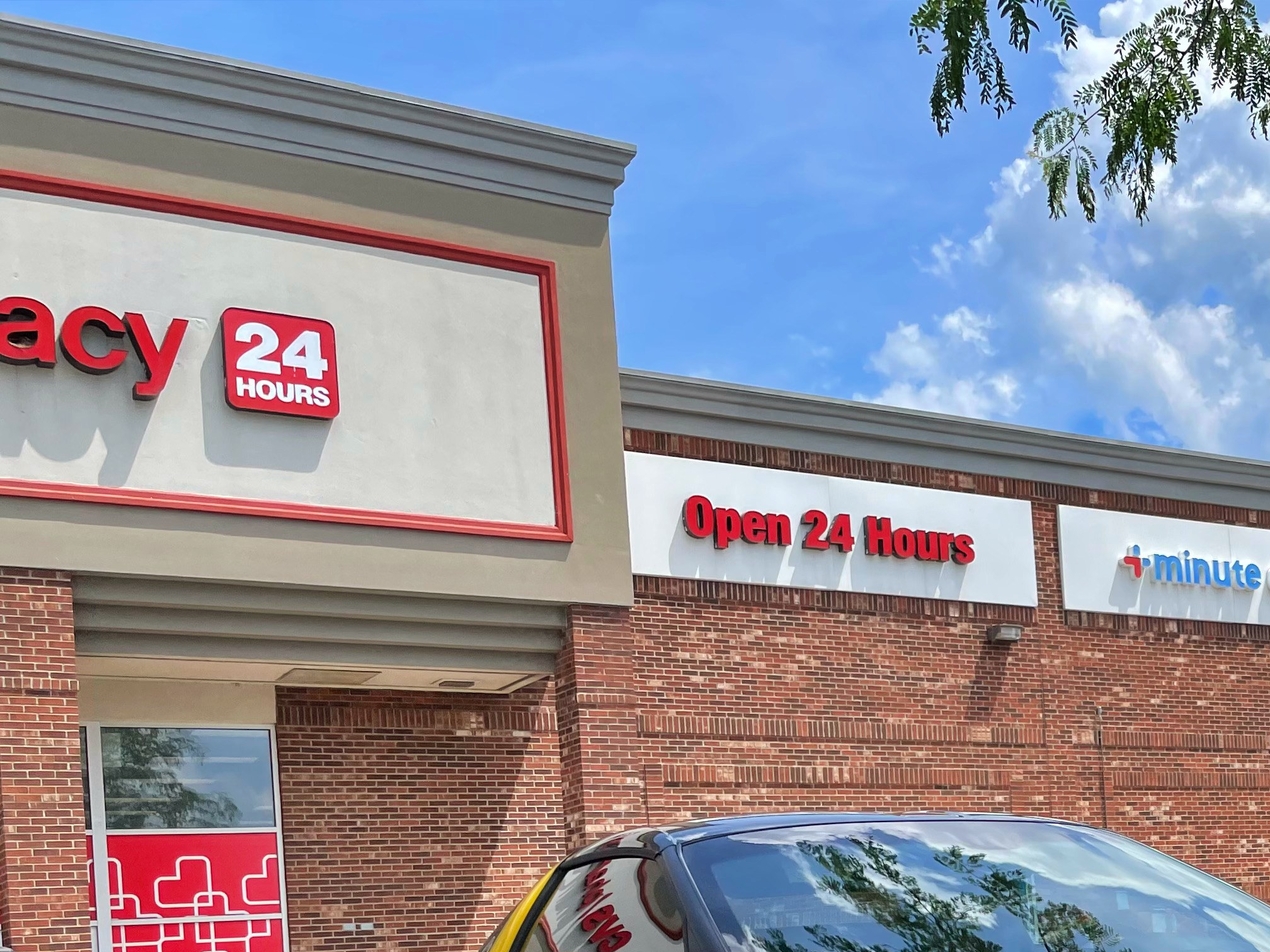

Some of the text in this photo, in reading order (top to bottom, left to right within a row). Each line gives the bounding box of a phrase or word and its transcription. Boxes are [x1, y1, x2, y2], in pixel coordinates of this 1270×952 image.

[234, 322, 328, 380] 24
[235, 376, 330, 407] HOURS
[682, 495, 975, 565] Open 24 Hours
[1152, 549, 1262, 591] minute
